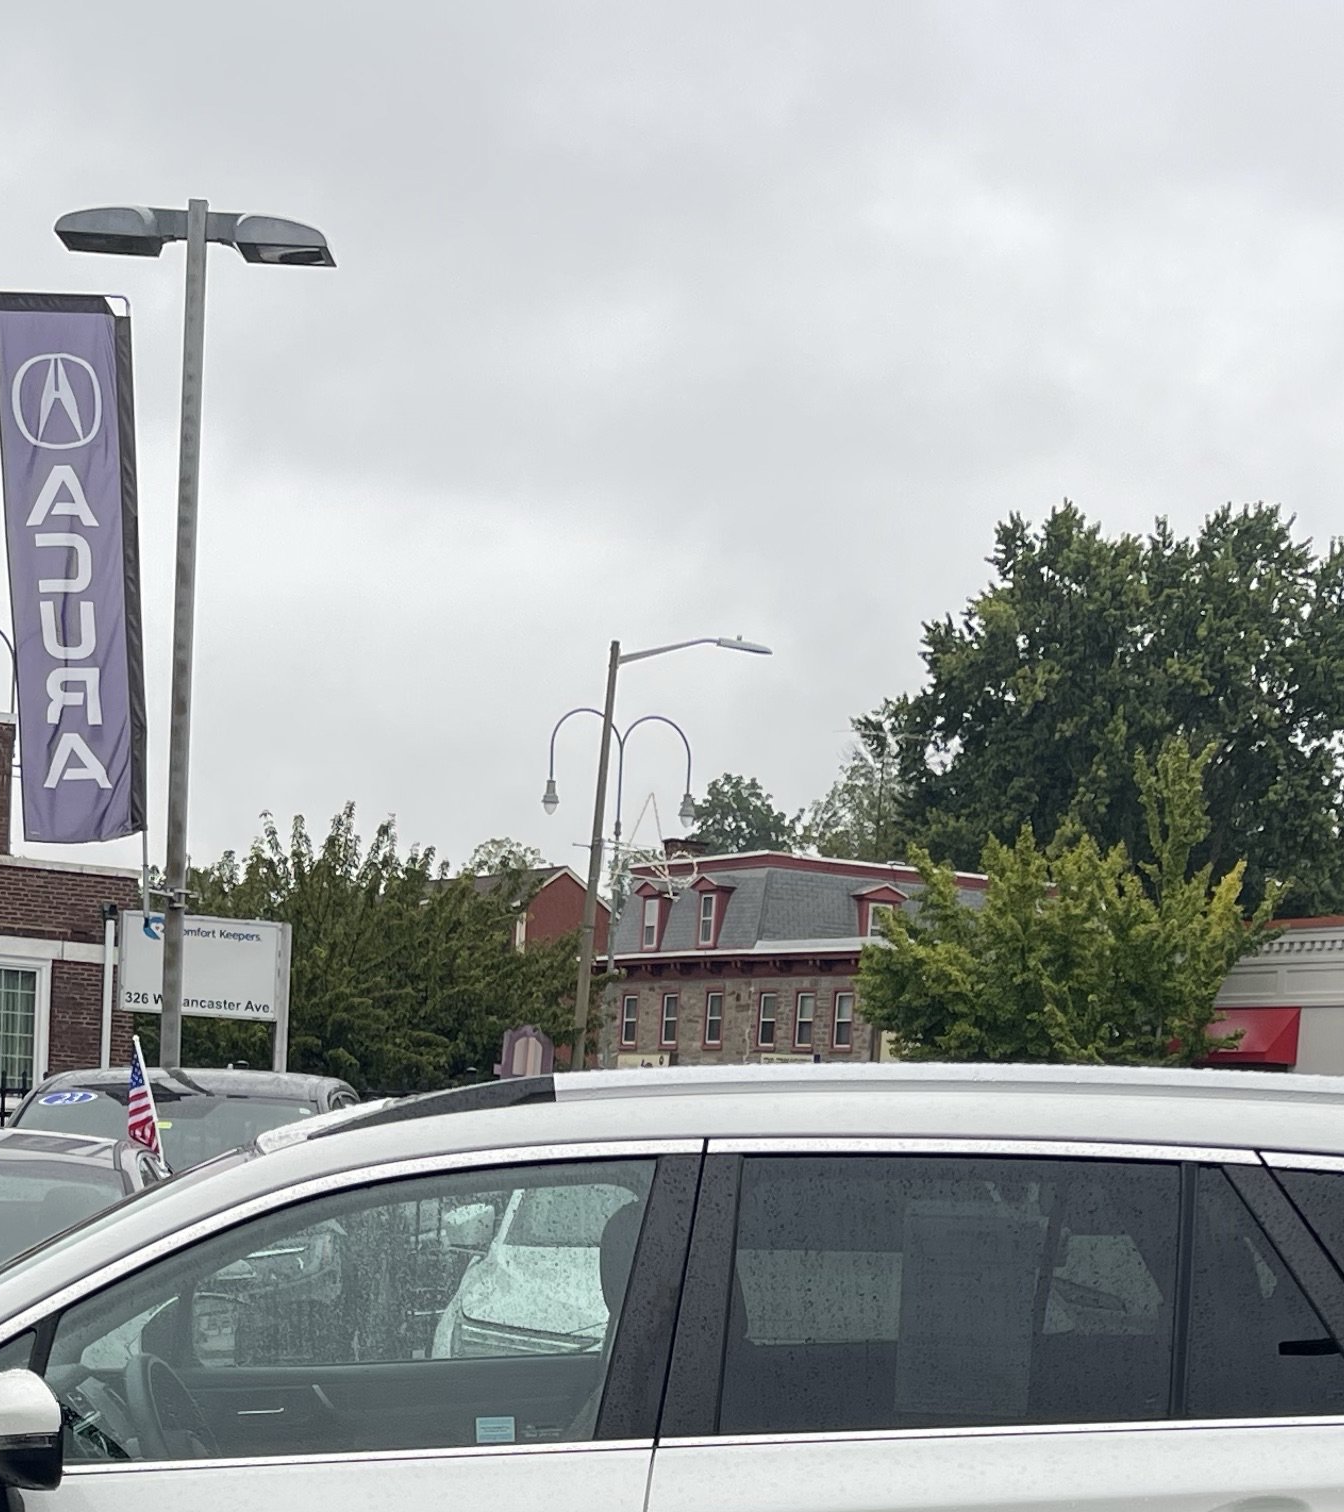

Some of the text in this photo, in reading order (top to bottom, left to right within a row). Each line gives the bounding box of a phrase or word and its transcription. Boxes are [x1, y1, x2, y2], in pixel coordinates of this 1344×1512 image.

[183, 928, 216, 939] omfort
[125, 991, 149, 1004] 326
[183, 998, 241, 1011] ancaster
